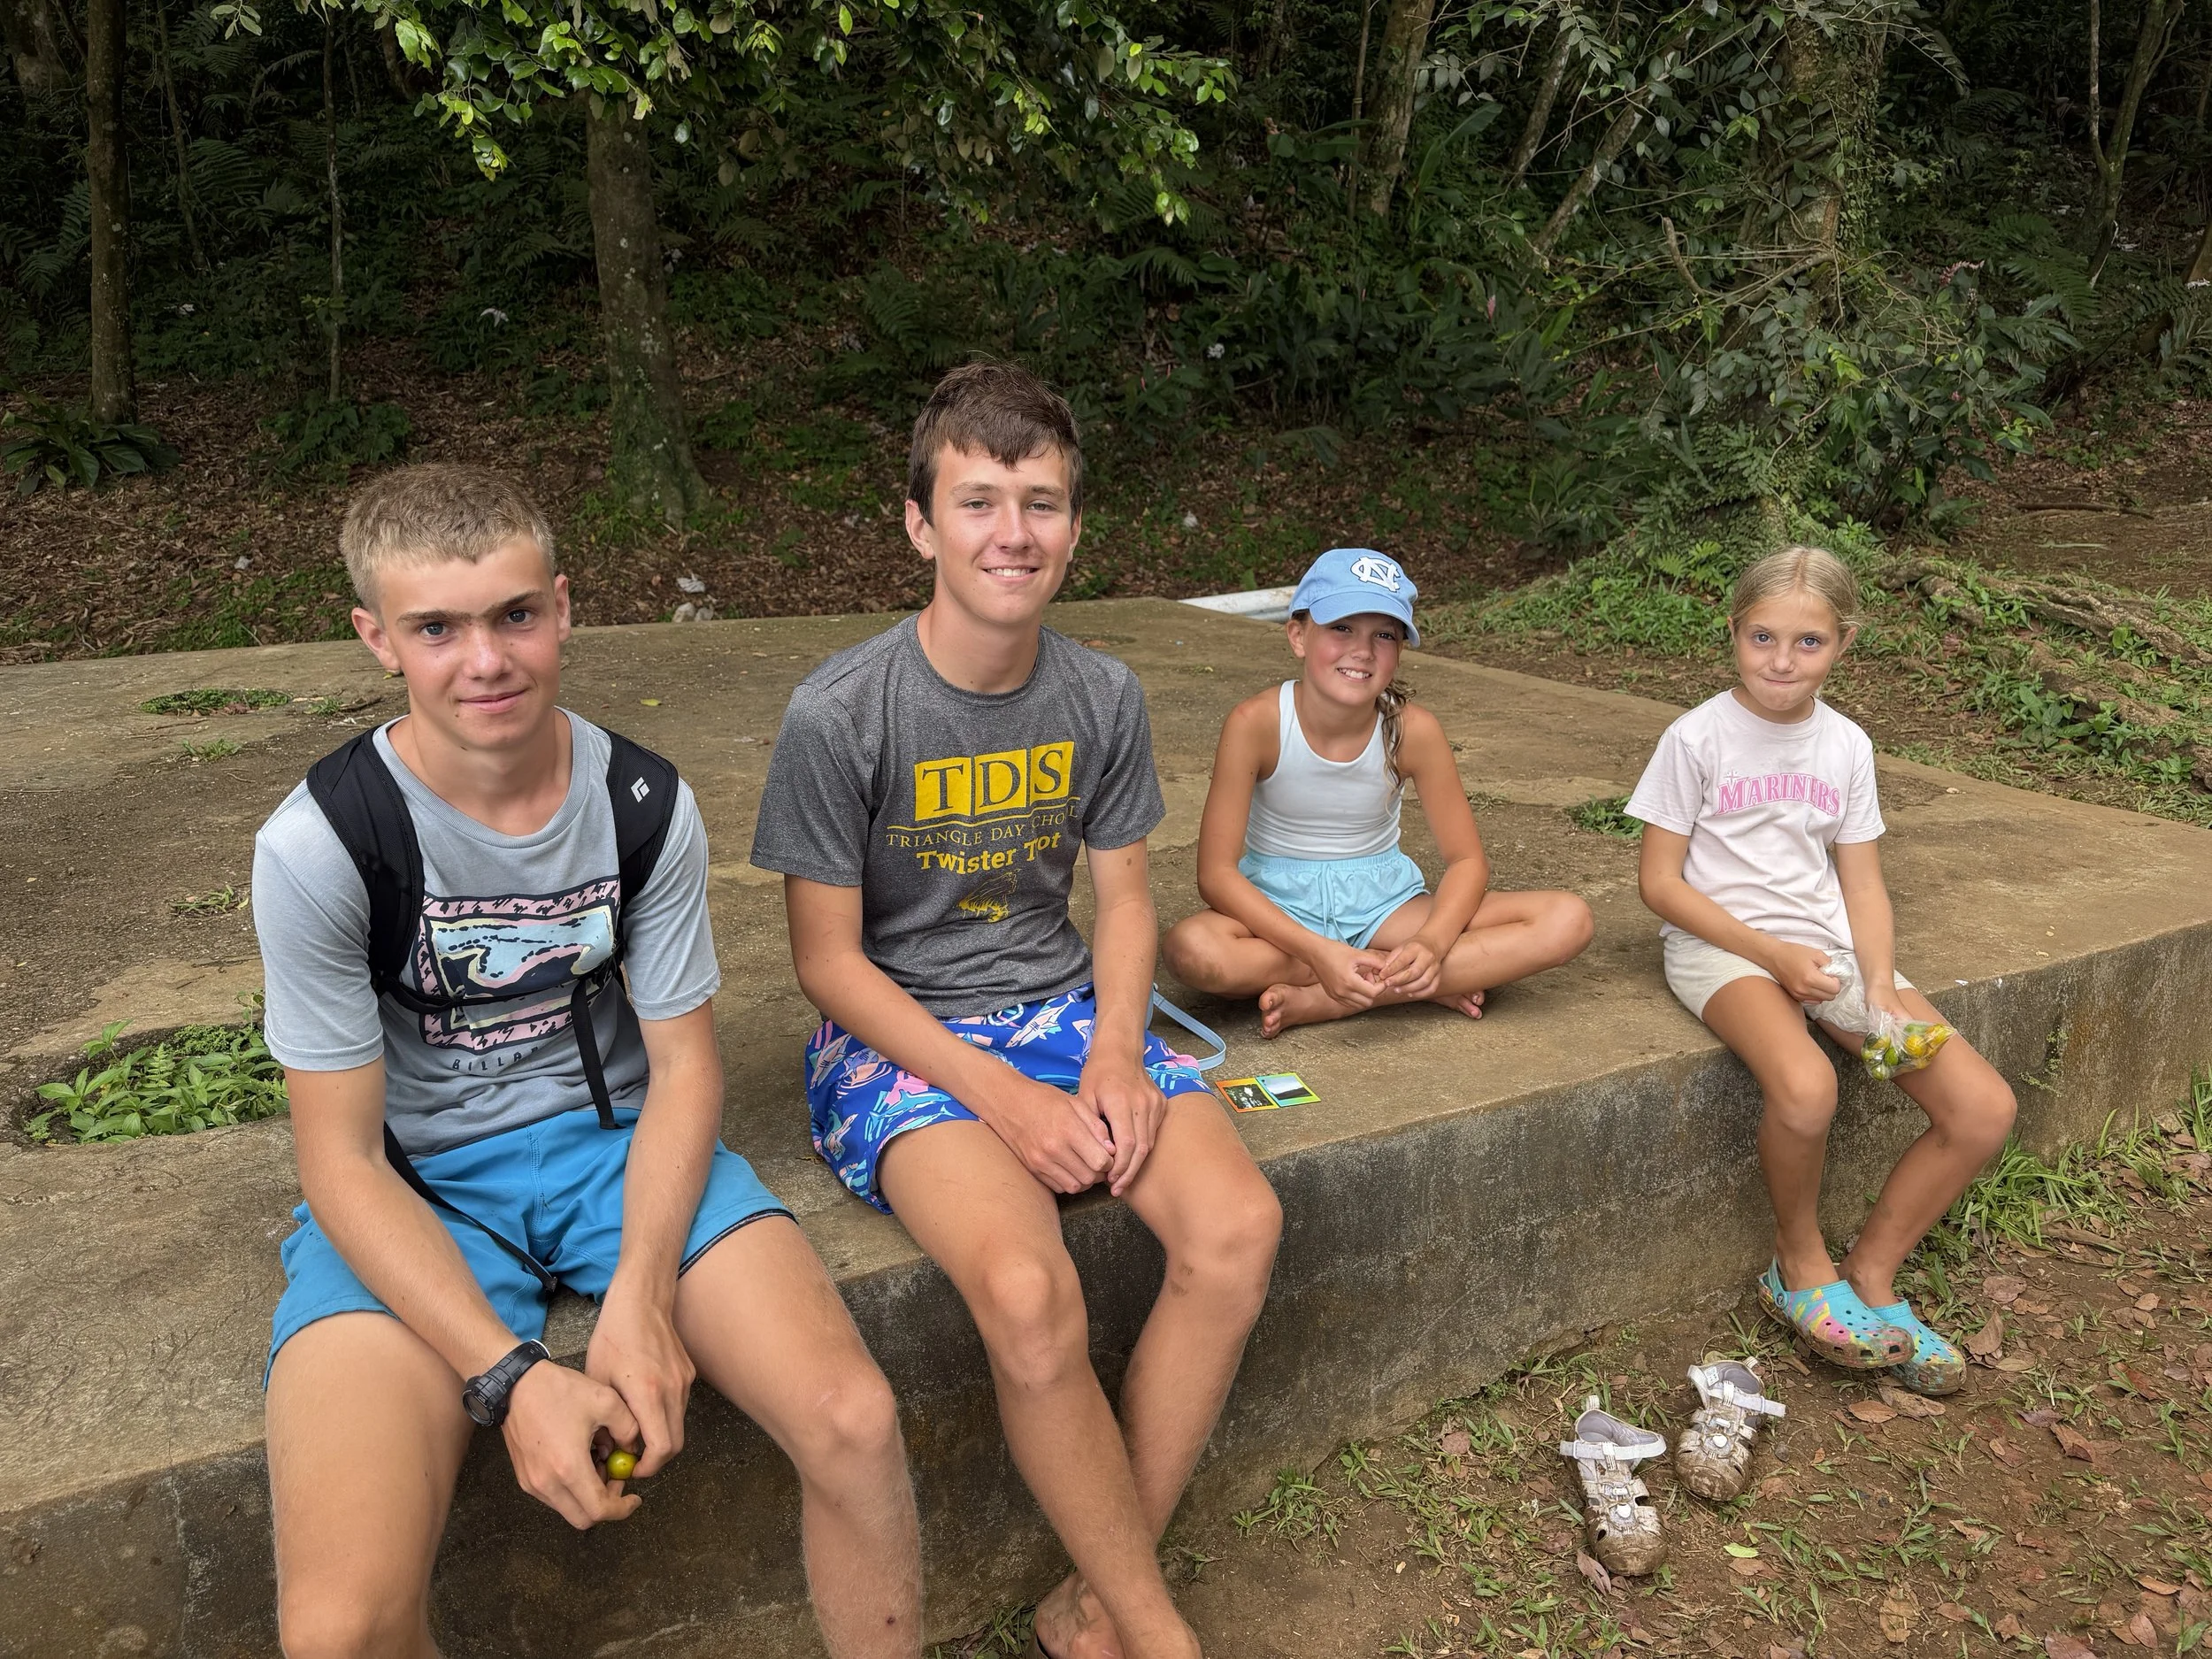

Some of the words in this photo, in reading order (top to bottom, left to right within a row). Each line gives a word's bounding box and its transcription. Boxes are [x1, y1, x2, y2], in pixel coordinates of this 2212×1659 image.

[921, 749, 1064, 812] TDS
[1715, 772, 1840, 817] MARINERS
[886, 830, 982, 847] TRIANGLE
[990, 824, 1025, 841] DAY
[917, 849, 1017, 875] Twister
